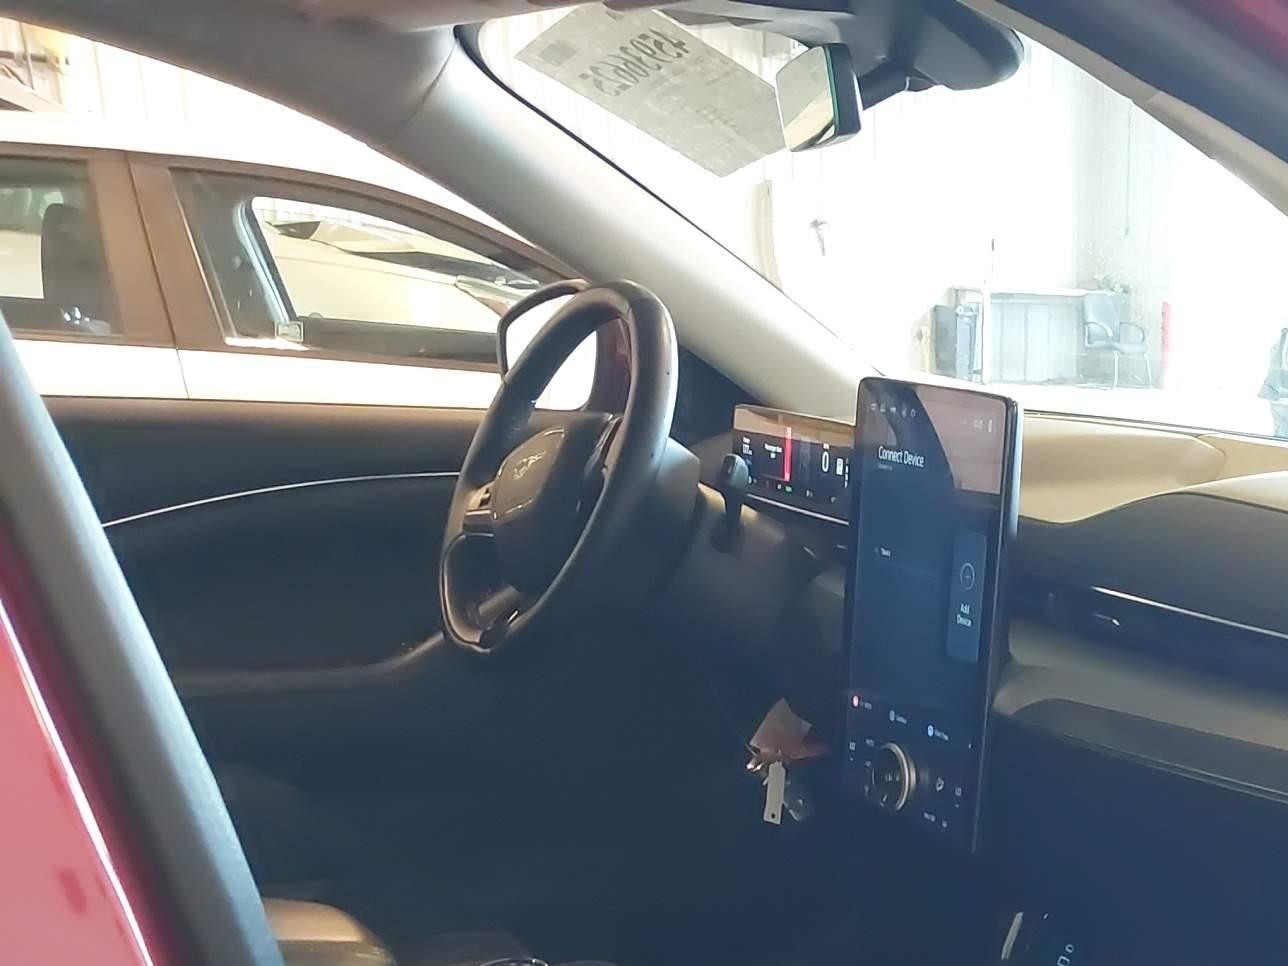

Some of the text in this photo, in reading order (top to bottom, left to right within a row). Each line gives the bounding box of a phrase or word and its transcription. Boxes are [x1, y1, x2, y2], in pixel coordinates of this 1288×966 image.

[821, 452, 830, 473] 0
[878, 446, 902, 464] Connect
[903, 450, 925, 468] Device
